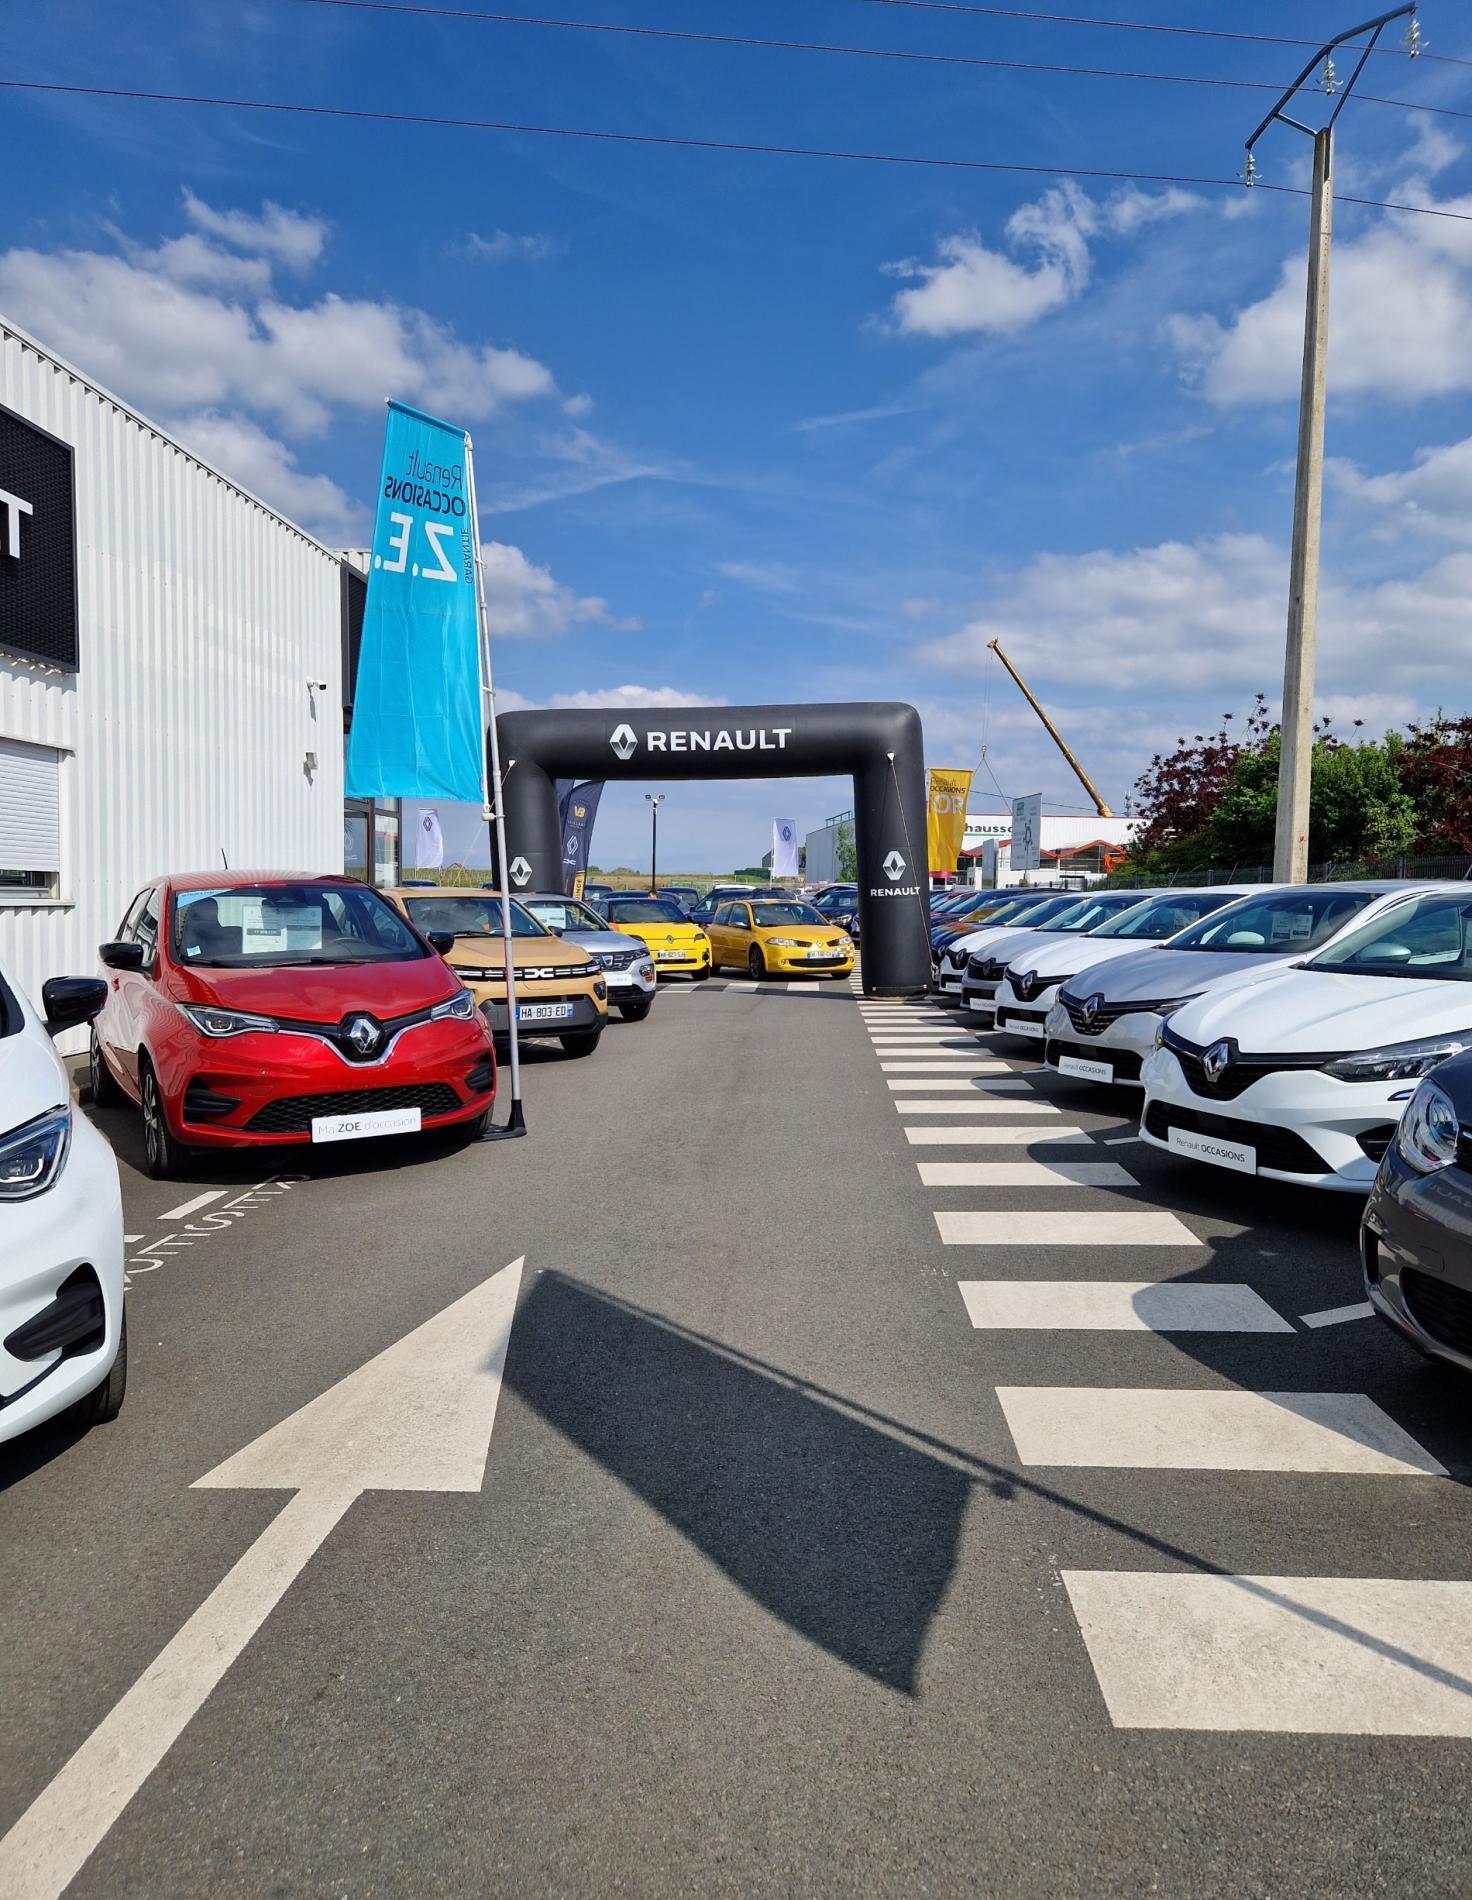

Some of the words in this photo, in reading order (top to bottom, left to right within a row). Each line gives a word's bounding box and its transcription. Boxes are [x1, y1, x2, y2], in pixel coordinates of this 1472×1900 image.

[0, 488, 33, 559] T
[647, 728, 792, 752] RENAULT
[929, 785, 967, 794] OCCASIONS
[933, 793, 964, 815] OR
[964, 822, 1013, 833] hausso
[870, 886, 921, 897] RENAULT
[1079, 1064, 1107, 1076] OCCASIONS
[318, 1125, 335, 1135] Ma
[337, 1122, 362, 1133] ZOE
[364, 1117, 416, 1130] d'occasion
[1176, 1137, 1200, 1151] Renault
[1201, 1144, 1246, 1163] OCCASIONS
